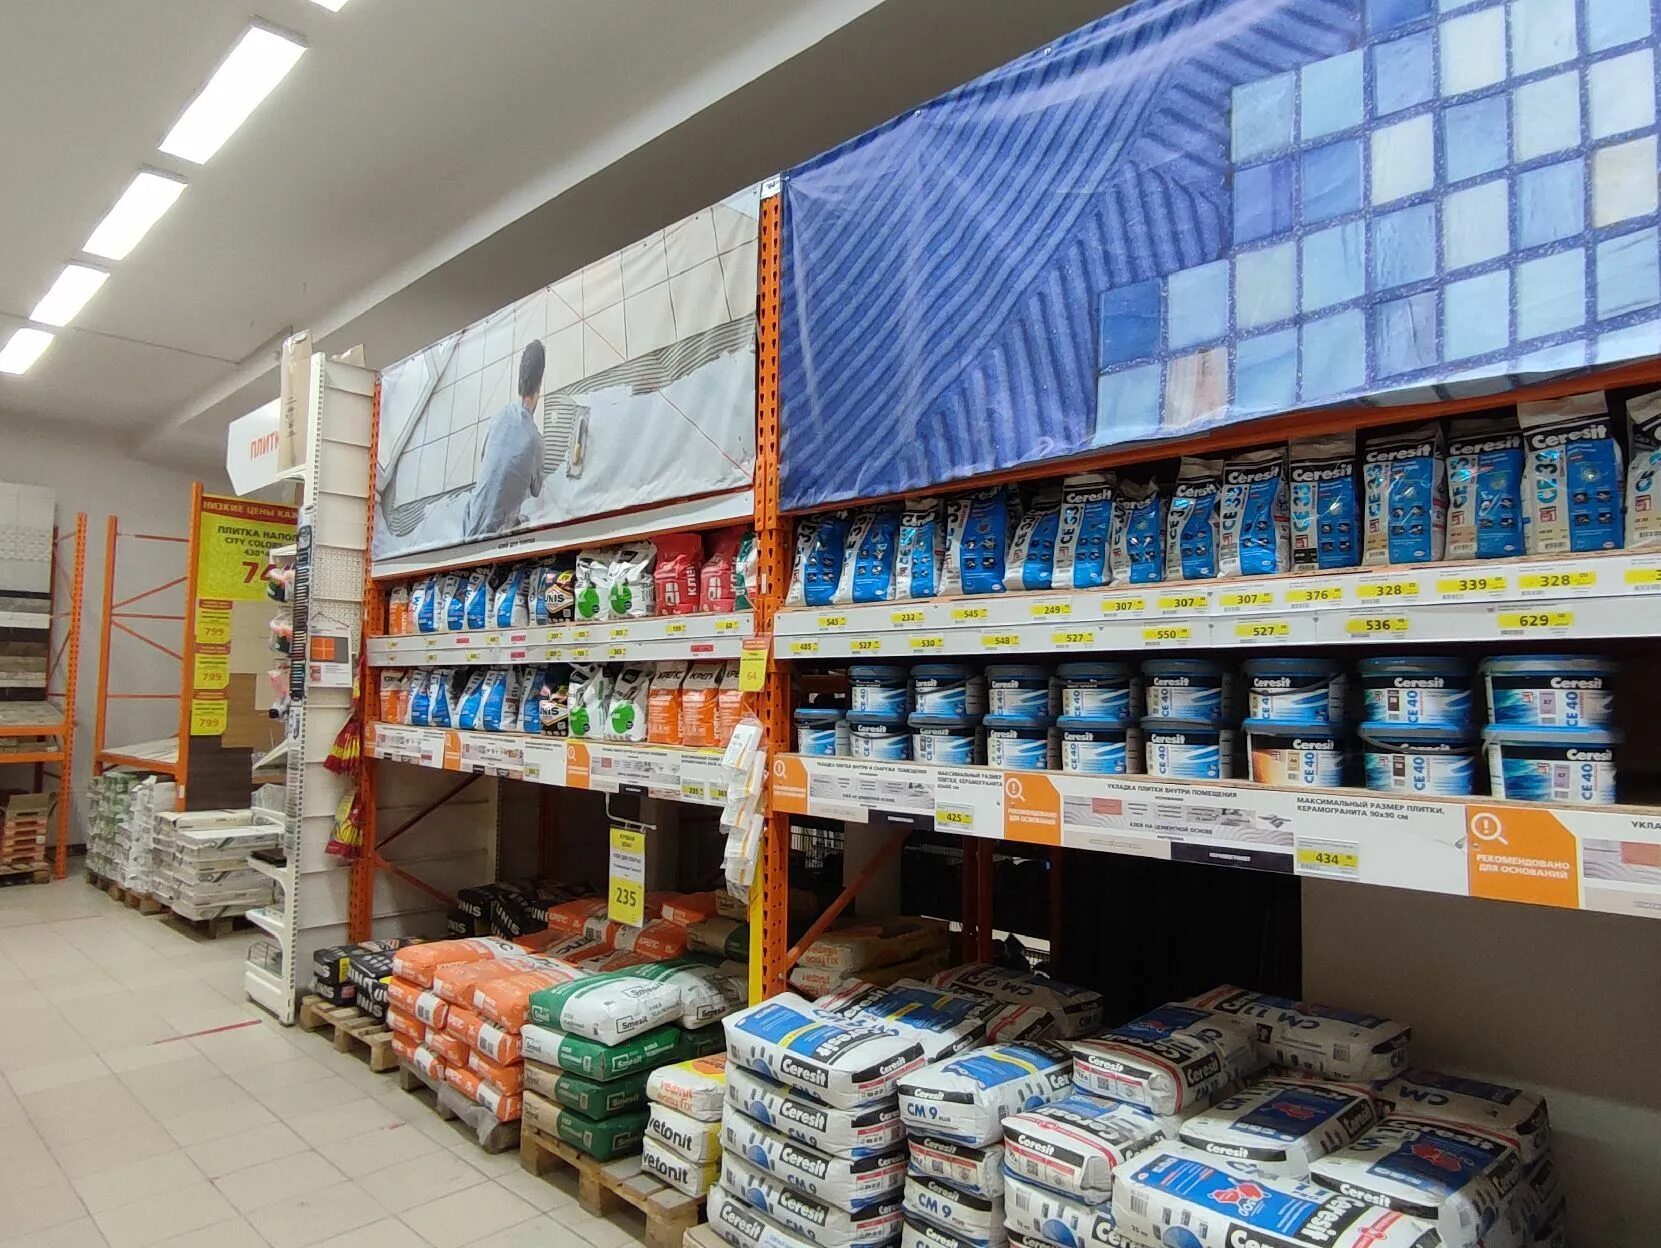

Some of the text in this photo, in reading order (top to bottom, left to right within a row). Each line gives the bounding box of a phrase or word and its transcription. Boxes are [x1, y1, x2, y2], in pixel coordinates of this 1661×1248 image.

[1531, 424, 1607, 449] Ceresit
[1365, 443, 1432, 462] Ceresit
[1450, 436, 1521, 456] Ceresit
[1228, 465, 1280, 485] Ceresit
[1292, 463, 1353, 481] Ceresit
[1066, 489, 1112, 504] Ceresit
[1452, 482, 1469, 509] CE
[1535, 478, 1558, 504] CE
[247, 506, 274, 516] ЦЕНЫ
[1367, 493, 1382, 517] CE
[1222, 511, 1238, 532] CE
[1292, 510, 1312, 533] CE
[218, 525, 260, 538] ПЛИТКА
[224, 536, 247, 545] CITY
[1459, 579, 1487, 591] 339
[1540, 575, 1570, 587] 328
[1306, 589, 1329, 601] 376
[1376, 585, 1402, 596] 328
[1115, 602, 1133, 611] 307
[1174, 598, 1194, 608] 307
[1237, 594, 1258, 605] 307
[963, 609, 979, 618] 545
[1044, 605, 1061, 614] 249
[901, 613, 916, 622] 232
[1366, 619, 1391, 630] 536
[1519, 614, 1549, 627] 629
[205, 627, 225, 636] 799
[1066, 633, 1084, 643] 527
[1157, 630, 1177, 640] 550
[1253, 626, 1275, 637] 527
[858, 641, 872, 649] 527
[203, 673, 222, 681] 799
[916, 678, 938, 687] Ceresit
[991, 679, 1019, 688] Ceresit
[1153, 677, 1190, 687] Ceresit
[1253, 677, 1291, 688] Ceresit
[1394, 676, 1445, 688] Ceresit
[1075, 690, 1081, 702] 40
[1161, 688, 1169, 702] 40
[1406, 689, 1419, 723] CE 40
[1565, 691, 1579, 727] CE 40
[199, 718, 220, 728] 799
[857, 725, 888, 733] Ceresit
[919, 728, 950, 737] Ceresit
[990, 729, 1018, 739] Ceresit
[1063, 731, 1094, 741] Ceresit
[1151, 733, 1186, 744] Ceresit
[1292, 739, 1335, 750] Ceresit
[1071, 743, 1078, 770] CE 40
[1158, 745, 1167, 774] CE 40
[1303, 752, 1315, 784] CE 40
[1412, 756, 1426, 791] CE 40
[1580, 763, 1593, 800] CE 40
[1107, 783, 1237, 799] УКЛАДКА ПЛИТКИ ВНУТРИ ПОМЕЩЕНИЯ
[1297, 797, 1368, 809] МАКСИМАЛЬНЫЙ
[1370, 803, 1405, 811] РАЗМЕР
[1297, 805, 1368, 817] КЕРАМОГРАНИТА
[946, 813, 962, 823] 425
[1315, 852, 1339, 865] 434
[1476, 853, 1570, 870] РЕКОМЕНДОВАНО
[1479, 863, 1569, 880] ДЛЯ ОСНОВАНИЙ
[616, 887, 637, 907] 235
[621, 1017, 648, 1031] Smesit
[1277, 1012, 1320, 1030] CM
[879, 1056, 906, 1075] Ceresit
[1088, 1056, 1124, 1072] Ceresit
[1186, 1056, 1220, 1086] Ceresit
[782, 1058, 828, 1087] Ceresit
[914, 1088, 945, 1101] Ceresit
[1399, 1085, 1450, 1106] CM
[781, 1101, 826, 1131] Ceresit
[907, 1102, 938, 1120] CM 9
[648, 1117, 693, 1152] vetonit
[808, 1136, 818, 1149] 9
[923, 1138, 957, 1154] Ceresit
[1018, 1134, 1055, 1156] Ceresit
[1206, 1142, 1249, 1159] Ceresit
[643, 1151, 688, 1185] vetonit
[781, 1148, 826, 1177] Ceresit
[808, 1183, 817, 1195] 9
[928, 1181, 960, 1201] Ceresit
[1339, 1182, 1391, 1207] Ceresit
[780, 1191, 826, 1224] Ceresit
[918, 1192, 952, 1218] CM 9
[721, 1205, 763, 1240] Ceresit
[1301, 1193, 1366, 1242] Ceresit
[806, 1230, 816, 1242] 9
[925, 1227, 959, 1248] Ceresit
